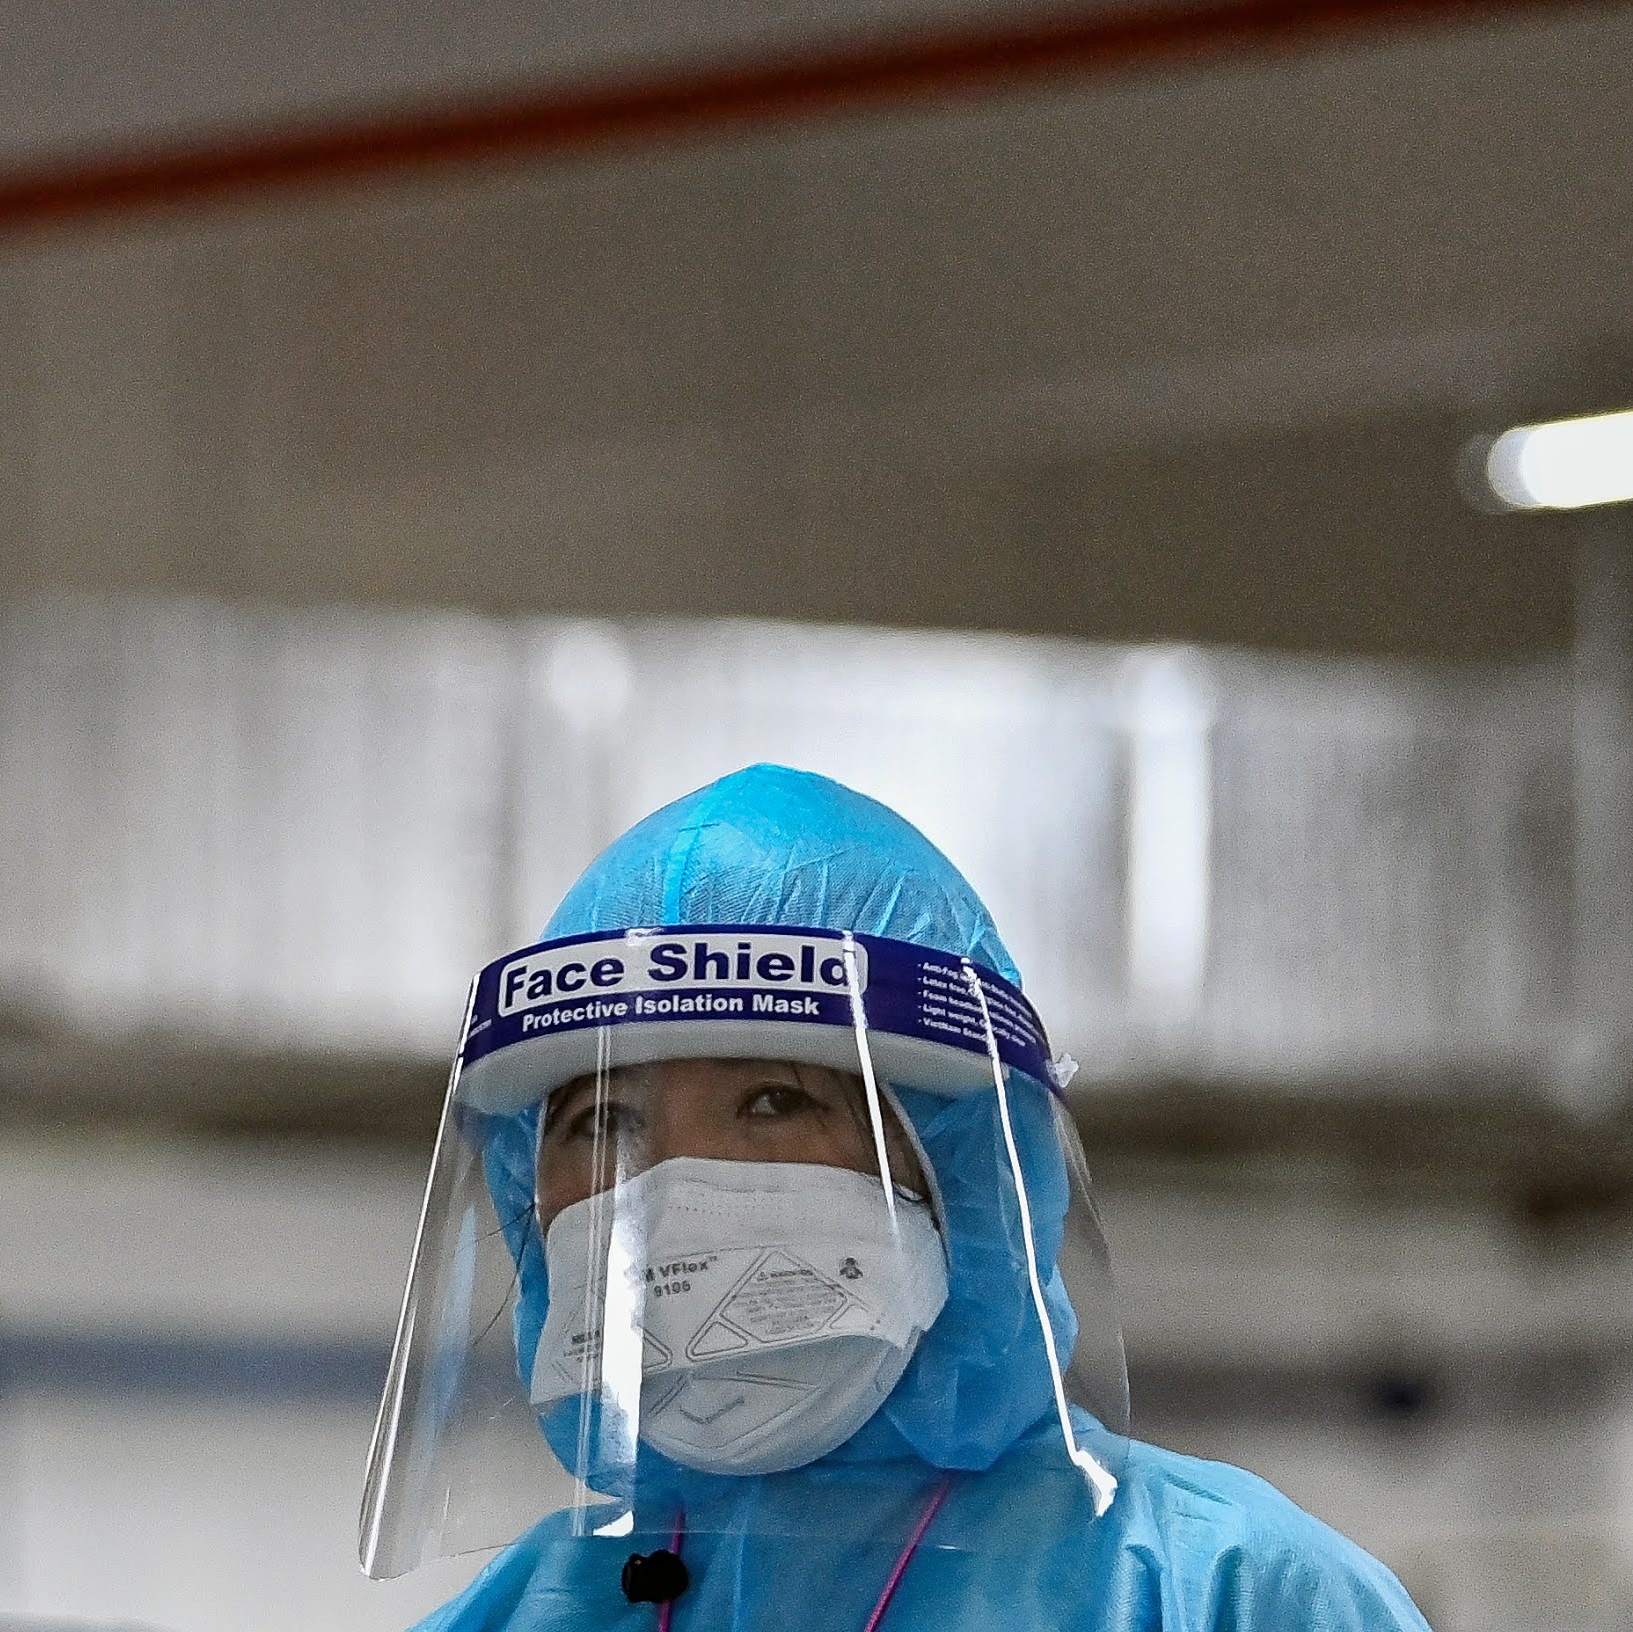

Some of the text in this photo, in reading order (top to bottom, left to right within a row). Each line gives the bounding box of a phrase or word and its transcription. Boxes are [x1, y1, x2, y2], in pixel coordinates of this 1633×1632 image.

[504, 957, 626, 1009] Face
[521, 993, 820, 1032] Protective Isolation Mask
